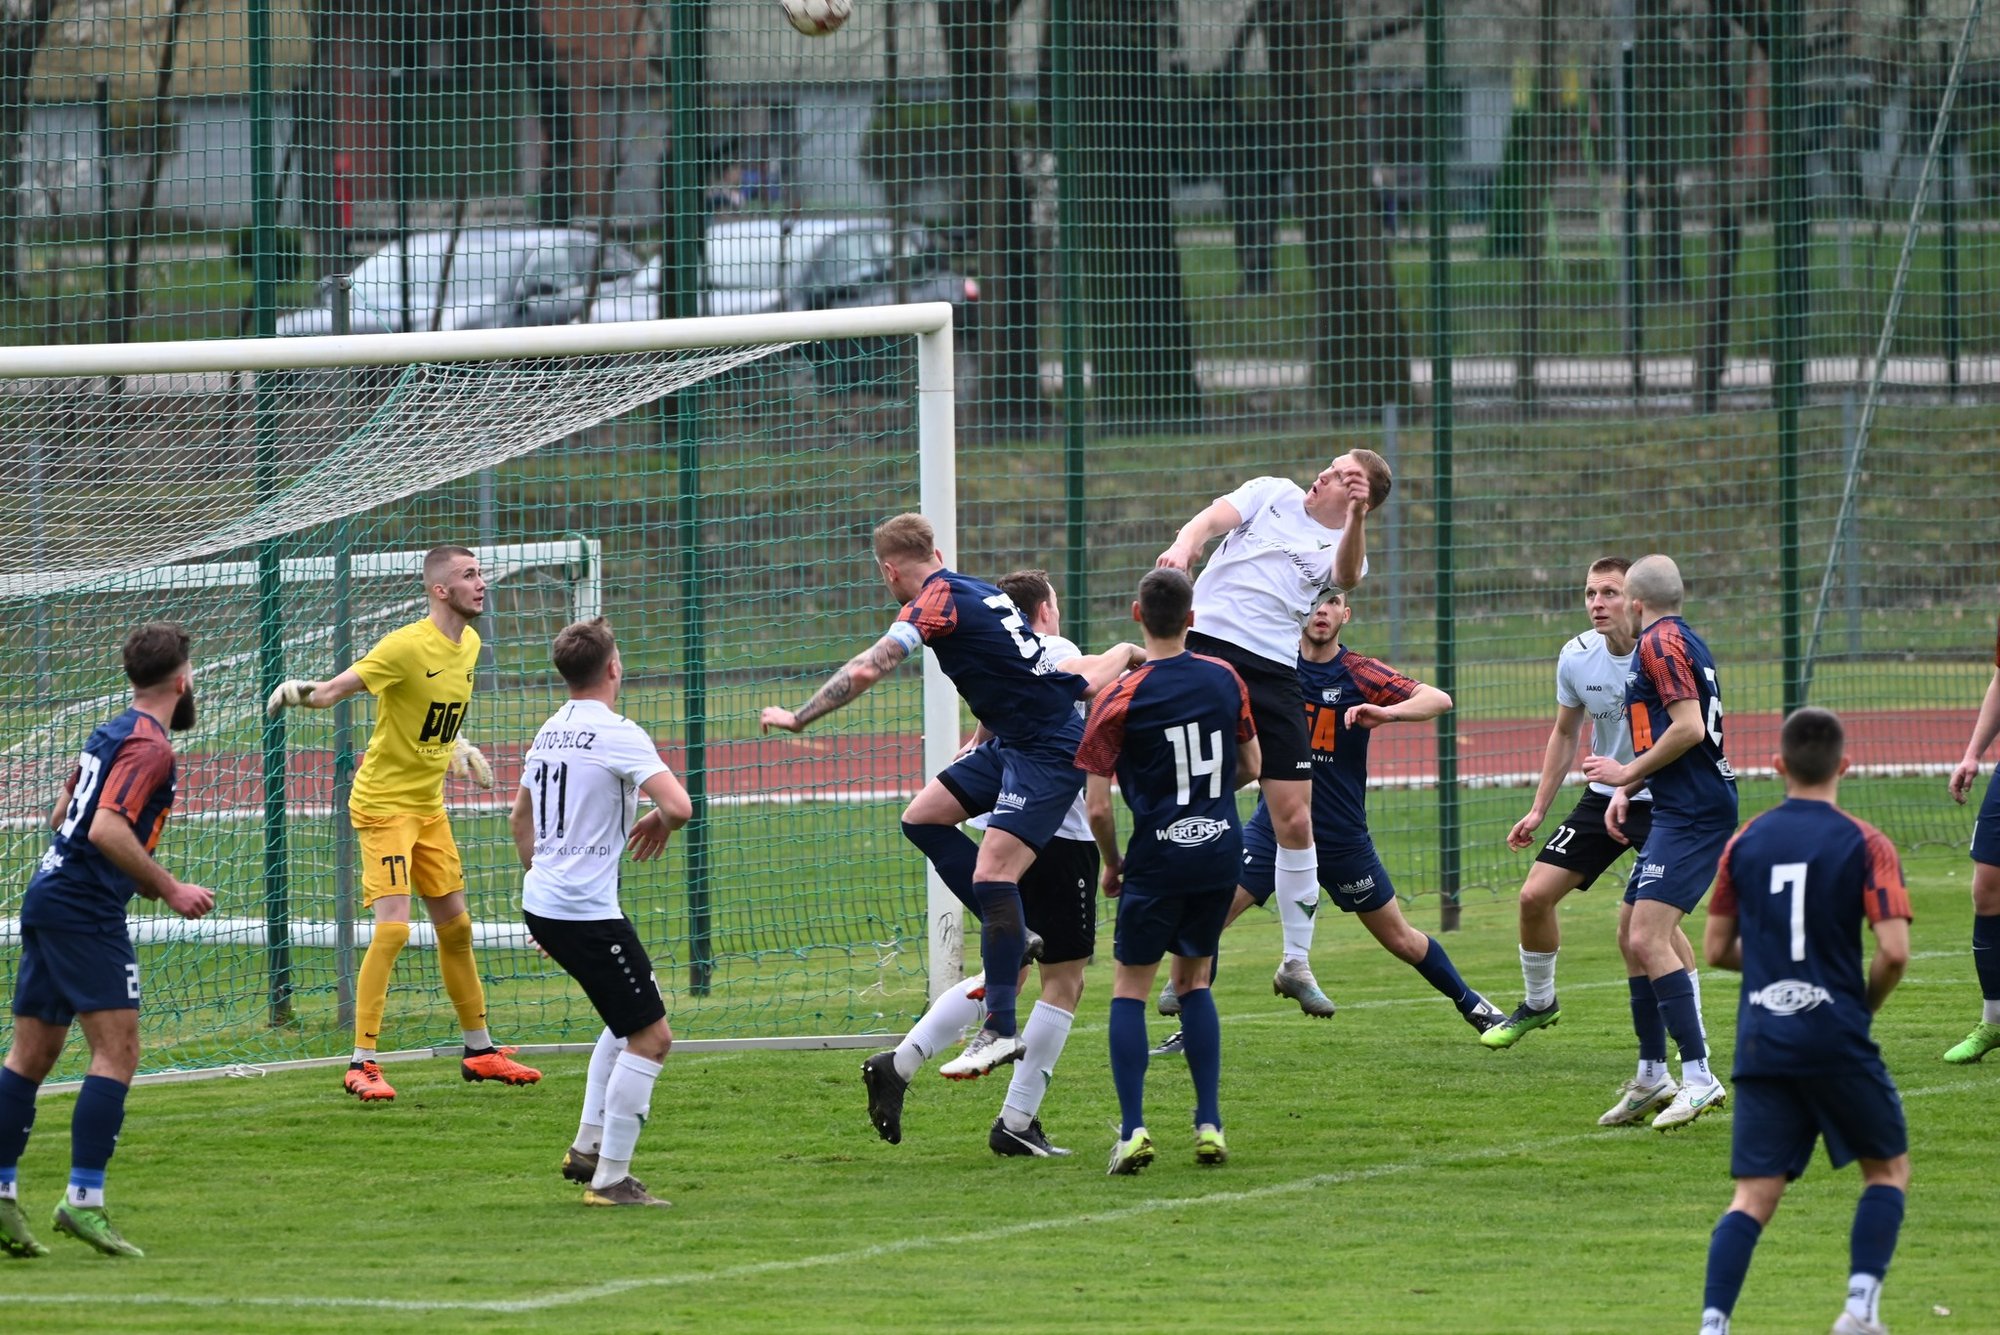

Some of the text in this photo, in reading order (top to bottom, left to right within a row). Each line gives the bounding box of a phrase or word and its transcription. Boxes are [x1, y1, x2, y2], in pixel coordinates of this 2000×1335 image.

[534, 761, 568, 839] 11
[1164, 722, 1224, 806] 14
[381, 855, 408, 886] 77
[1770, 862, 1808, 962] 7
